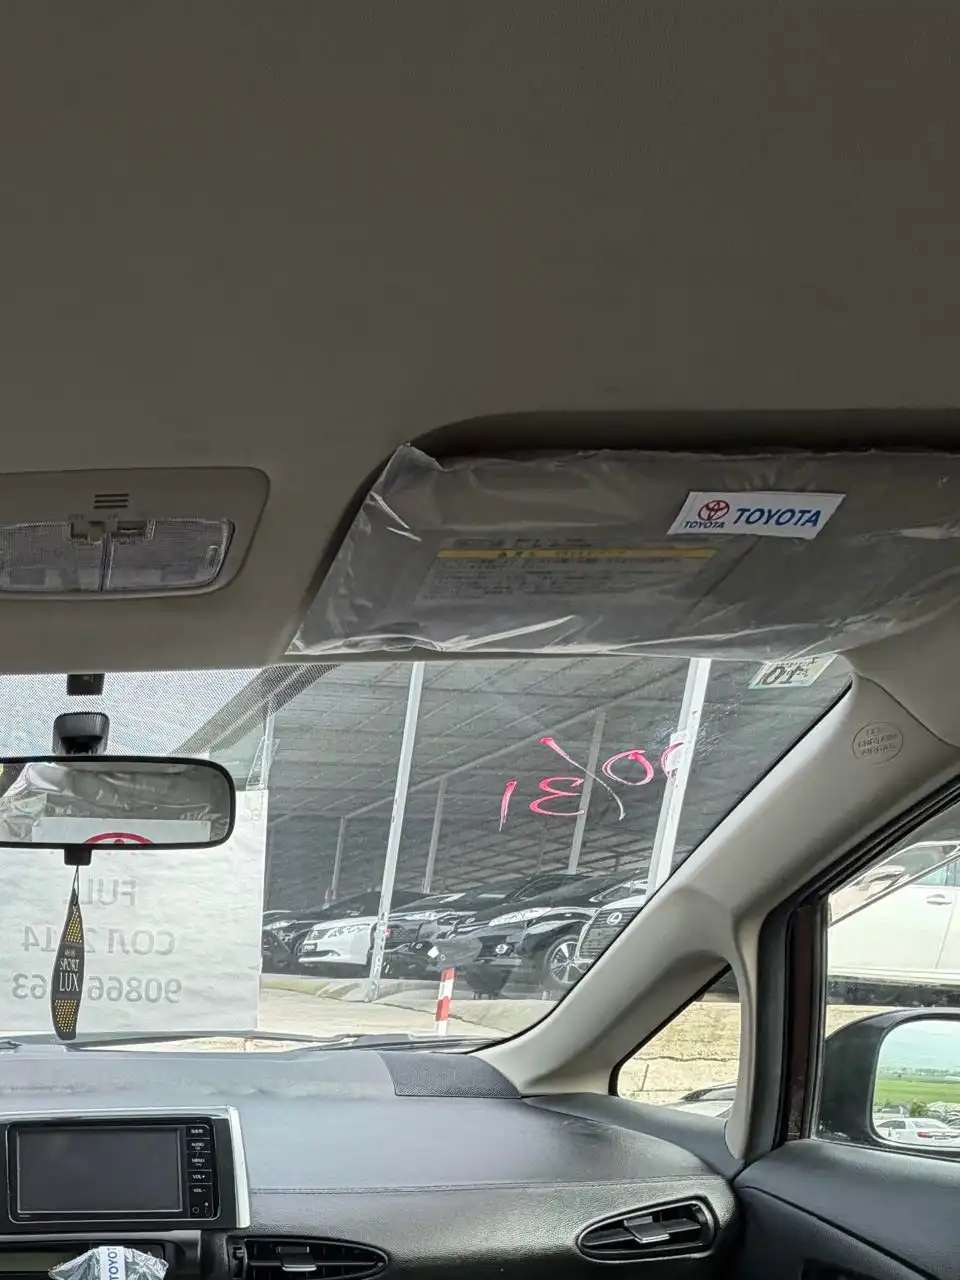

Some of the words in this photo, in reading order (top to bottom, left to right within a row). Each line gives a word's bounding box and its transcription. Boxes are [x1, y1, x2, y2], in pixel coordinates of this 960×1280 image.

[683, 520, 726, 529] TOYOTA
[733, 508, 822, 528] TOYOTA
[60, 972, 80, 992] LUX
